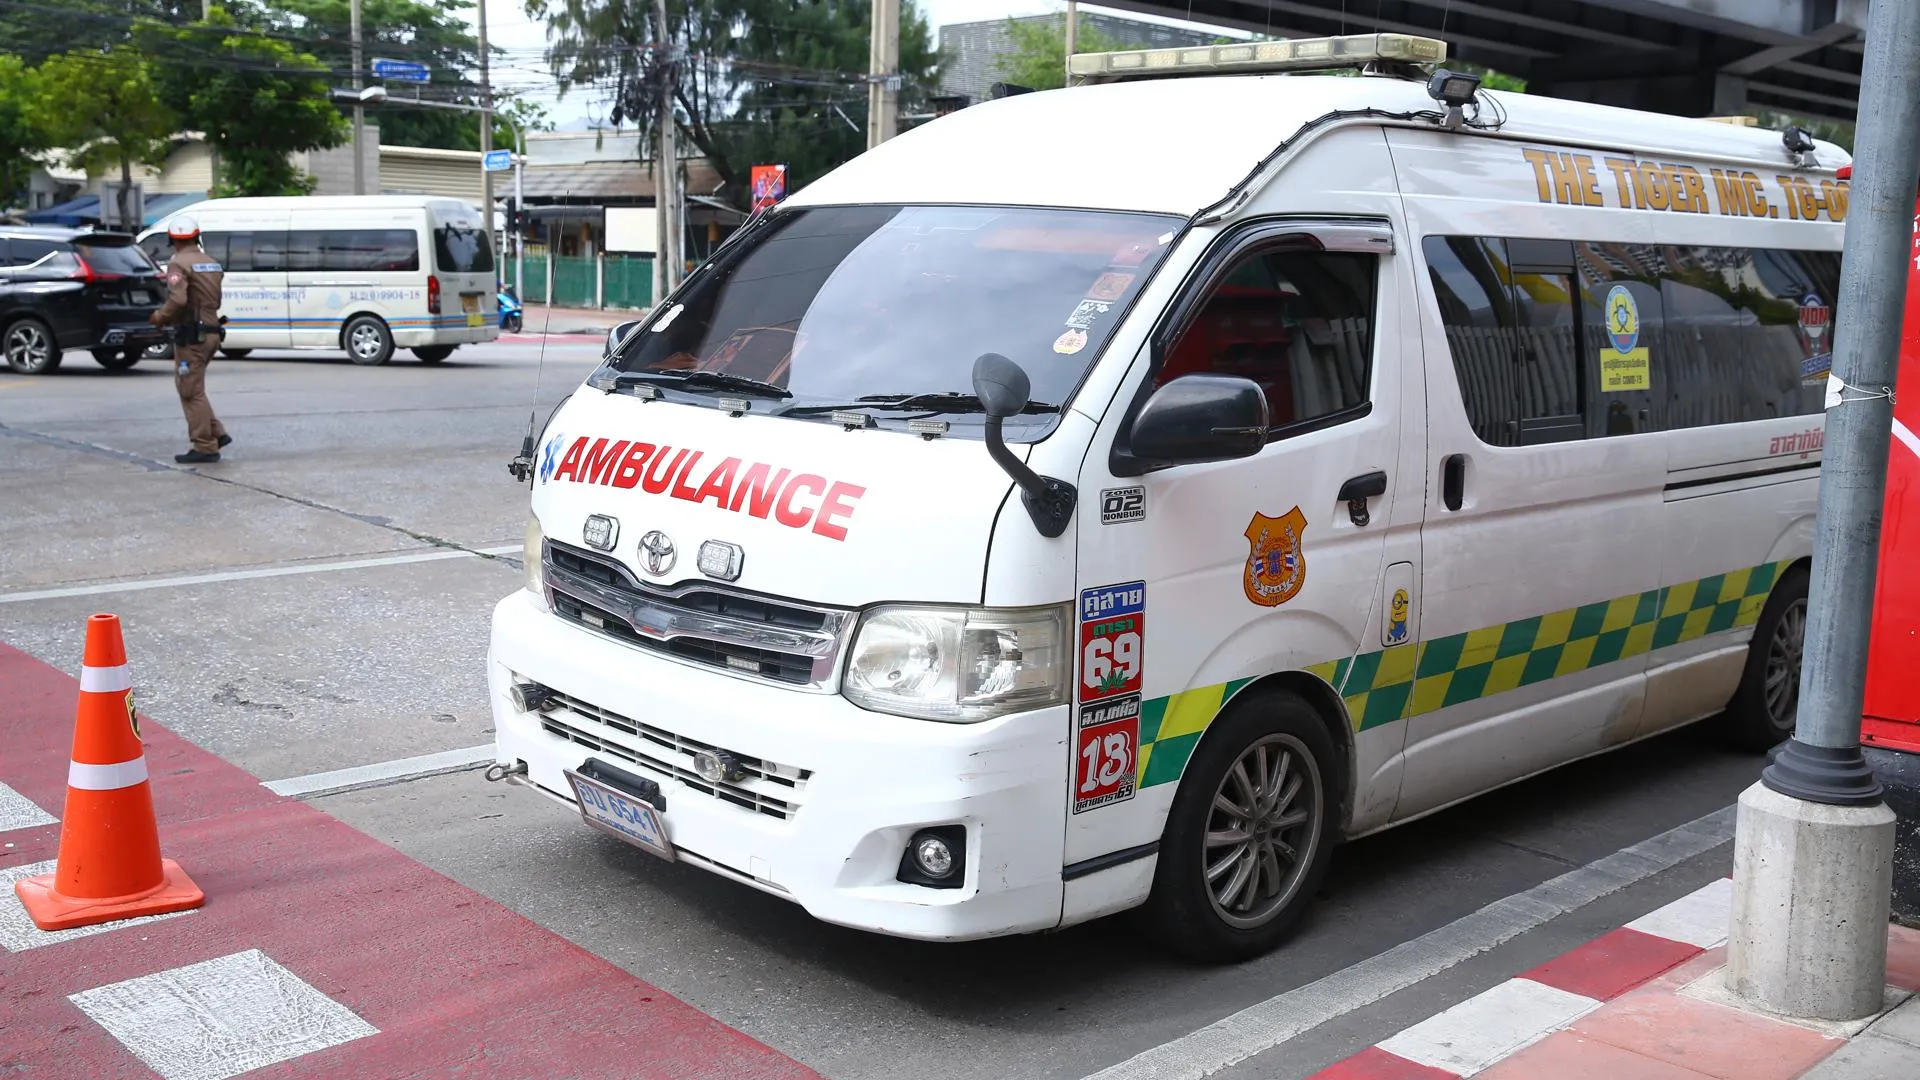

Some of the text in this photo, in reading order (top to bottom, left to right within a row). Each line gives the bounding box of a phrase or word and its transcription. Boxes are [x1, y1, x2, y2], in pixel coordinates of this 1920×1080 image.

[1522, 148, 1603, 207] THE
[1604, 157, 1710, 214] TIGER
[1710, 168, 1778, 218] MC.
[554, 436, 866, 541] AMBULANCE
[1103, 495, 1143, 513] 02
[1104, 489, 1141, 498] ZONE
[1103, 510, 1144, 520] NONBURI
[1084, 589, 1142, 617] คู่สาย
[1084, 632, 1140, 688] 69
[1081, 731, 1131, 793] 13
[607, 794, 656, 833] 6541
